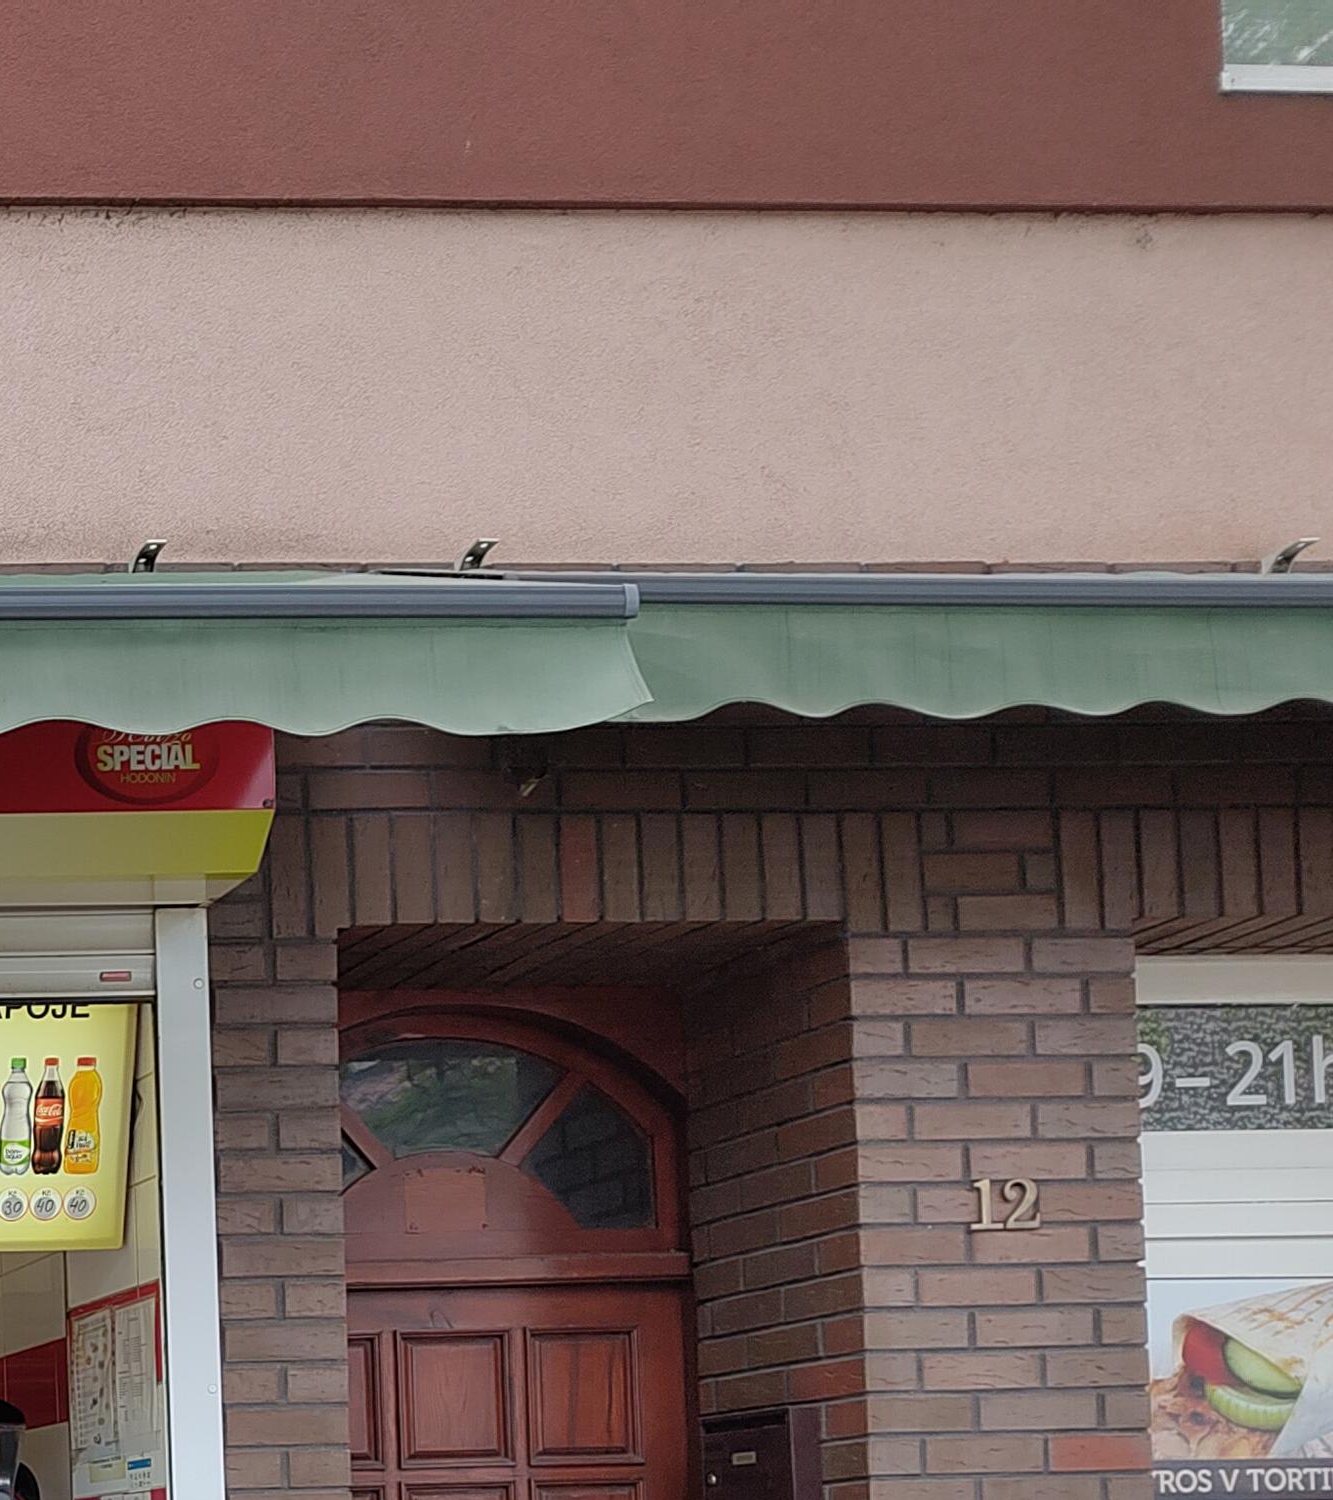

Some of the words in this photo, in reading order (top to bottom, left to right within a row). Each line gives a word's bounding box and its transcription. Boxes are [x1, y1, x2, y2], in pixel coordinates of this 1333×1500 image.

[97, 744, 200, 771] SPECIAL
[970, 1178, 1041, 1230] 12
[1218, 1469, 1240, 1492] V
[1246, 1467, 1333, 1491] TORTI
